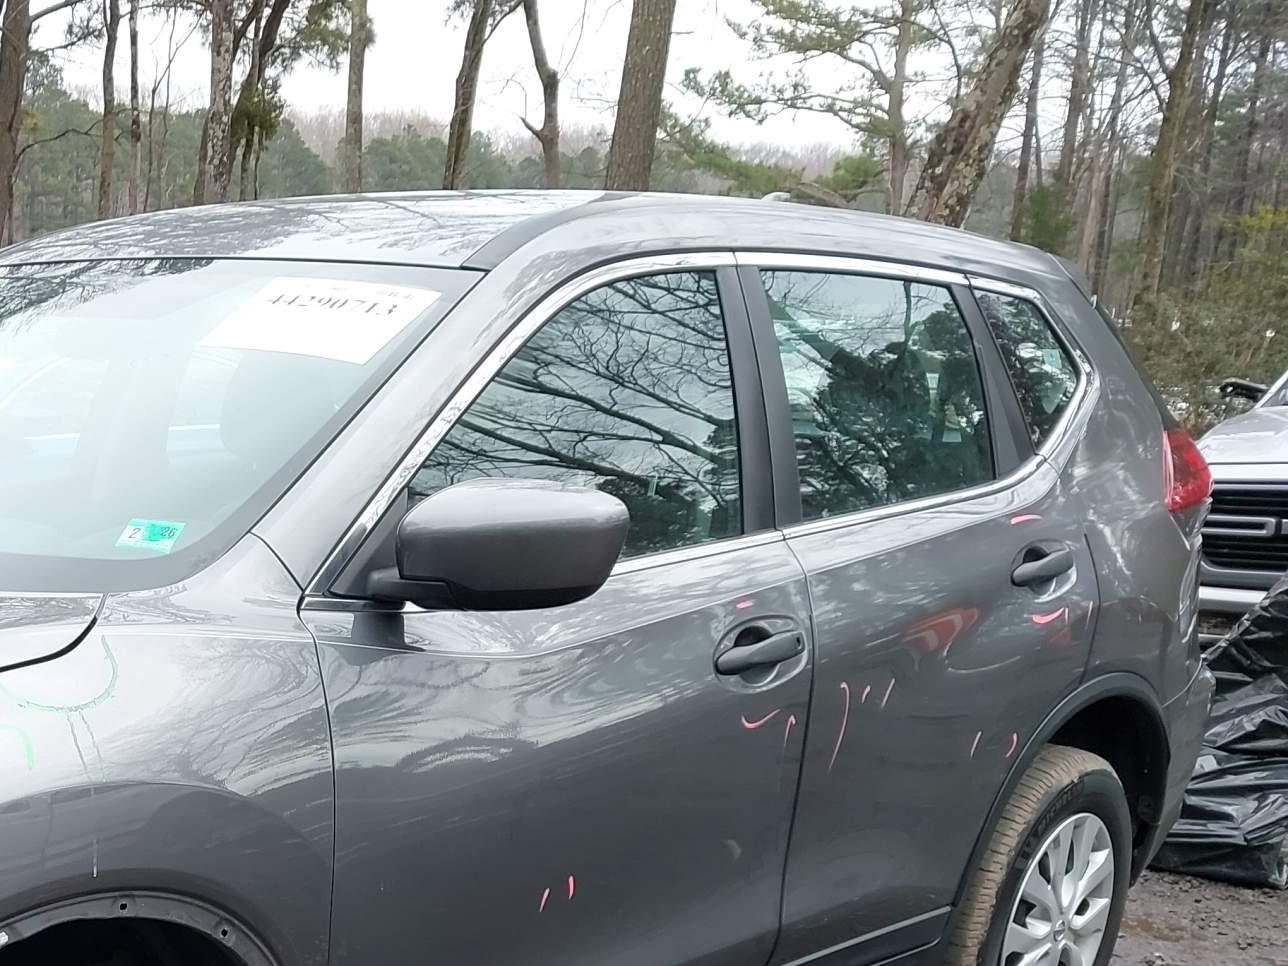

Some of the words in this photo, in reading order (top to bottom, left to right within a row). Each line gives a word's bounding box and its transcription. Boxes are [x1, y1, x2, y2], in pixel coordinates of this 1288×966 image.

[266, 293, 398, 316] 44290713
[128, 527, 142, 539] 2
[159, 526, 178, 539] 26
